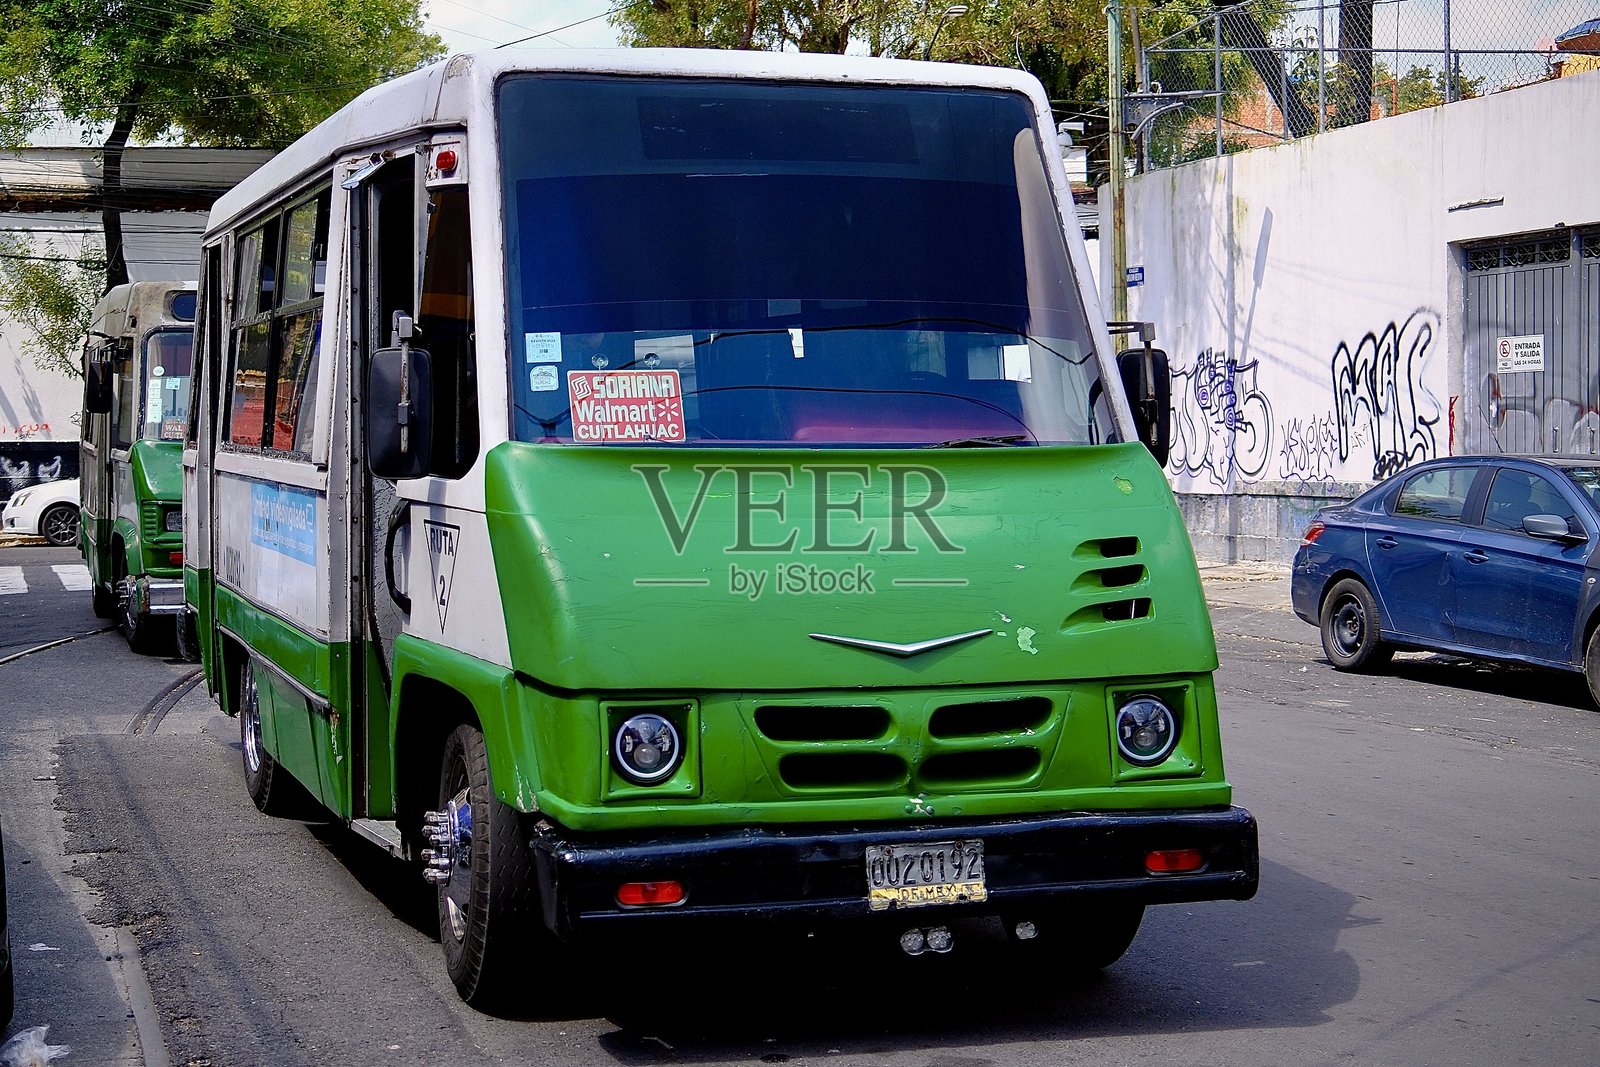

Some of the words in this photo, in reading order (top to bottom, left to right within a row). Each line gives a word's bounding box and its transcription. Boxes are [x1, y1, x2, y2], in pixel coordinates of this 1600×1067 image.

[1514, 342, 1541, 350] ENTRADA
[1520, 350, 1541, 358] SALIDA
[592, 374, 676, 399] SORIANA
[573, 400, 657, 423] Walmart
[430, 527, 455, 557] RUTA
[439, 574, 446, 607] 2
[871, 847, 981, 887] 0020192
